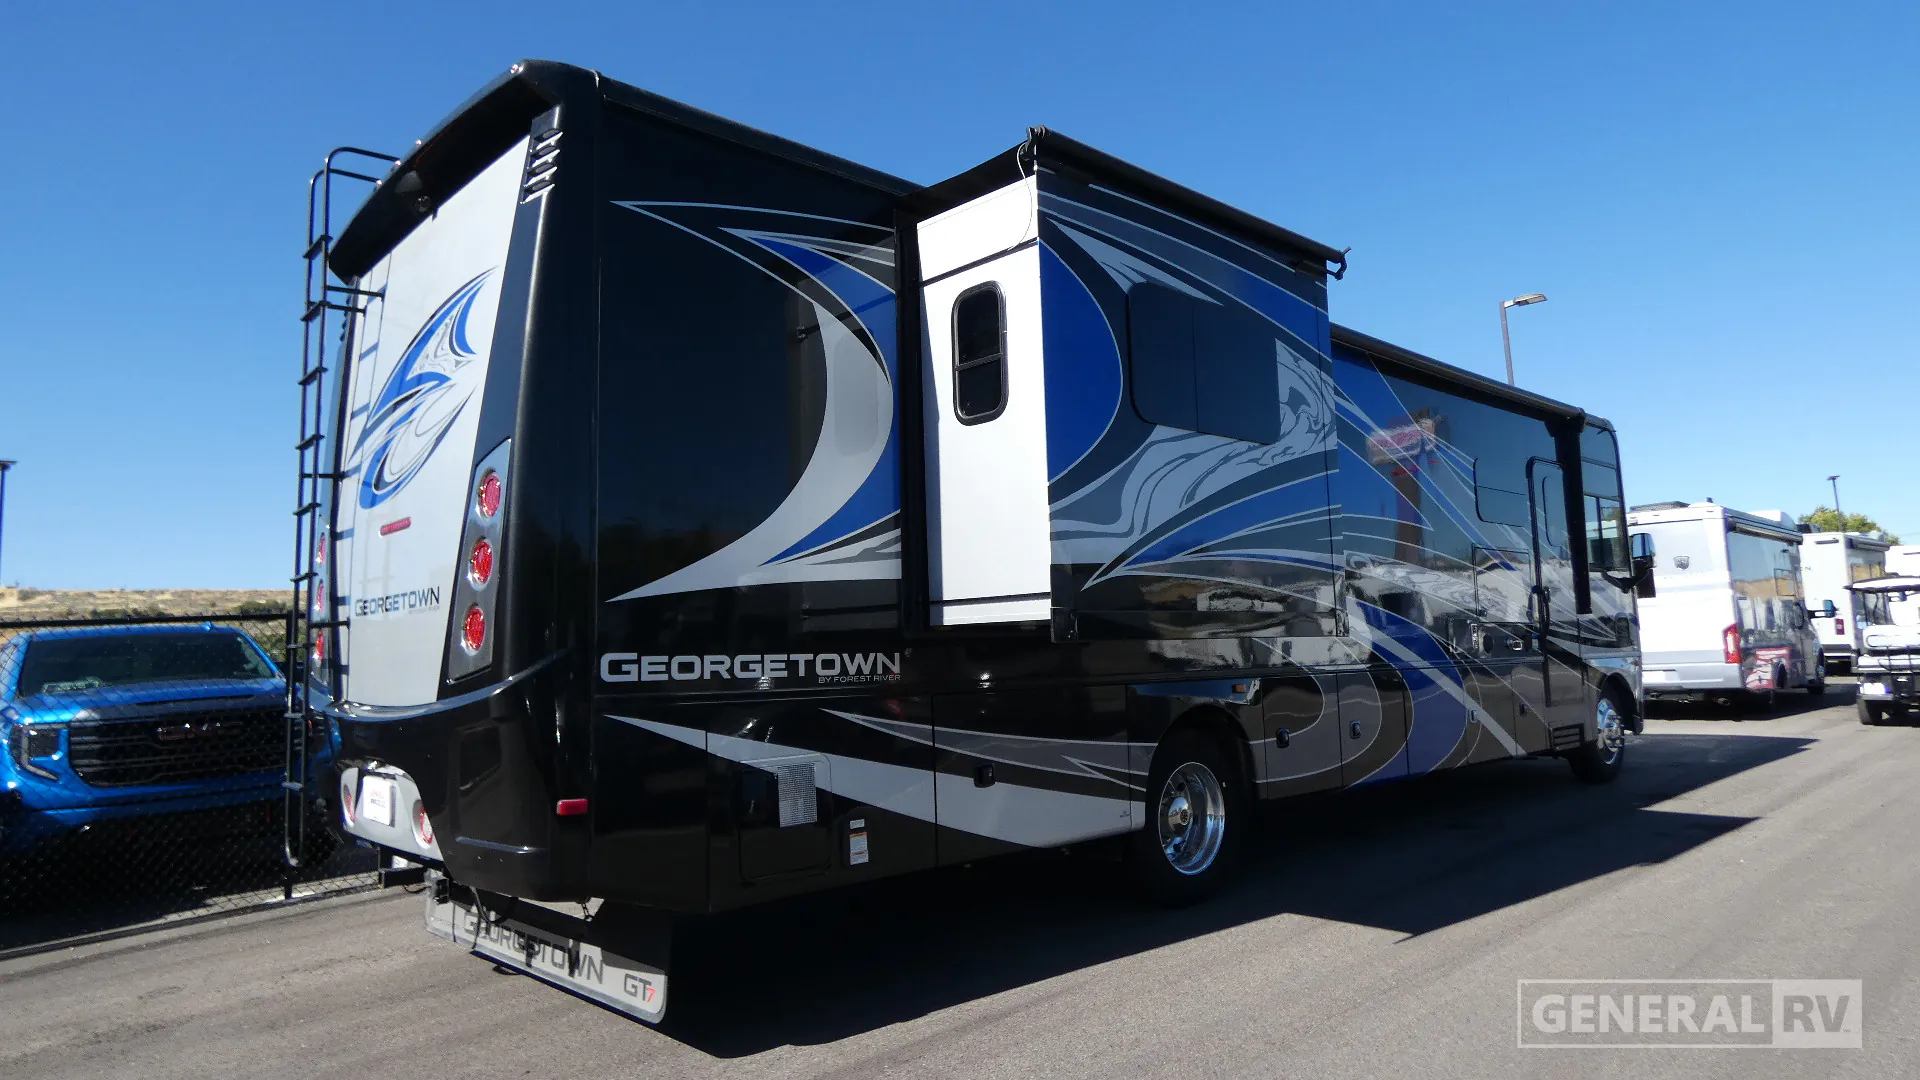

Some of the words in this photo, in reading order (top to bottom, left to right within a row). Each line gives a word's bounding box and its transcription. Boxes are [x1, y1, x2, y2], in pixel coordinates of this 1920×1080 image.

[355, 586, 440, 617] GEORGETOWN
[600, 652, 901, 682] GEORGETOWN
[818, 676, 832, 684] BY
[833, 675, 872, 683] FOREST
[873, 674, 901, 682] RIVER
